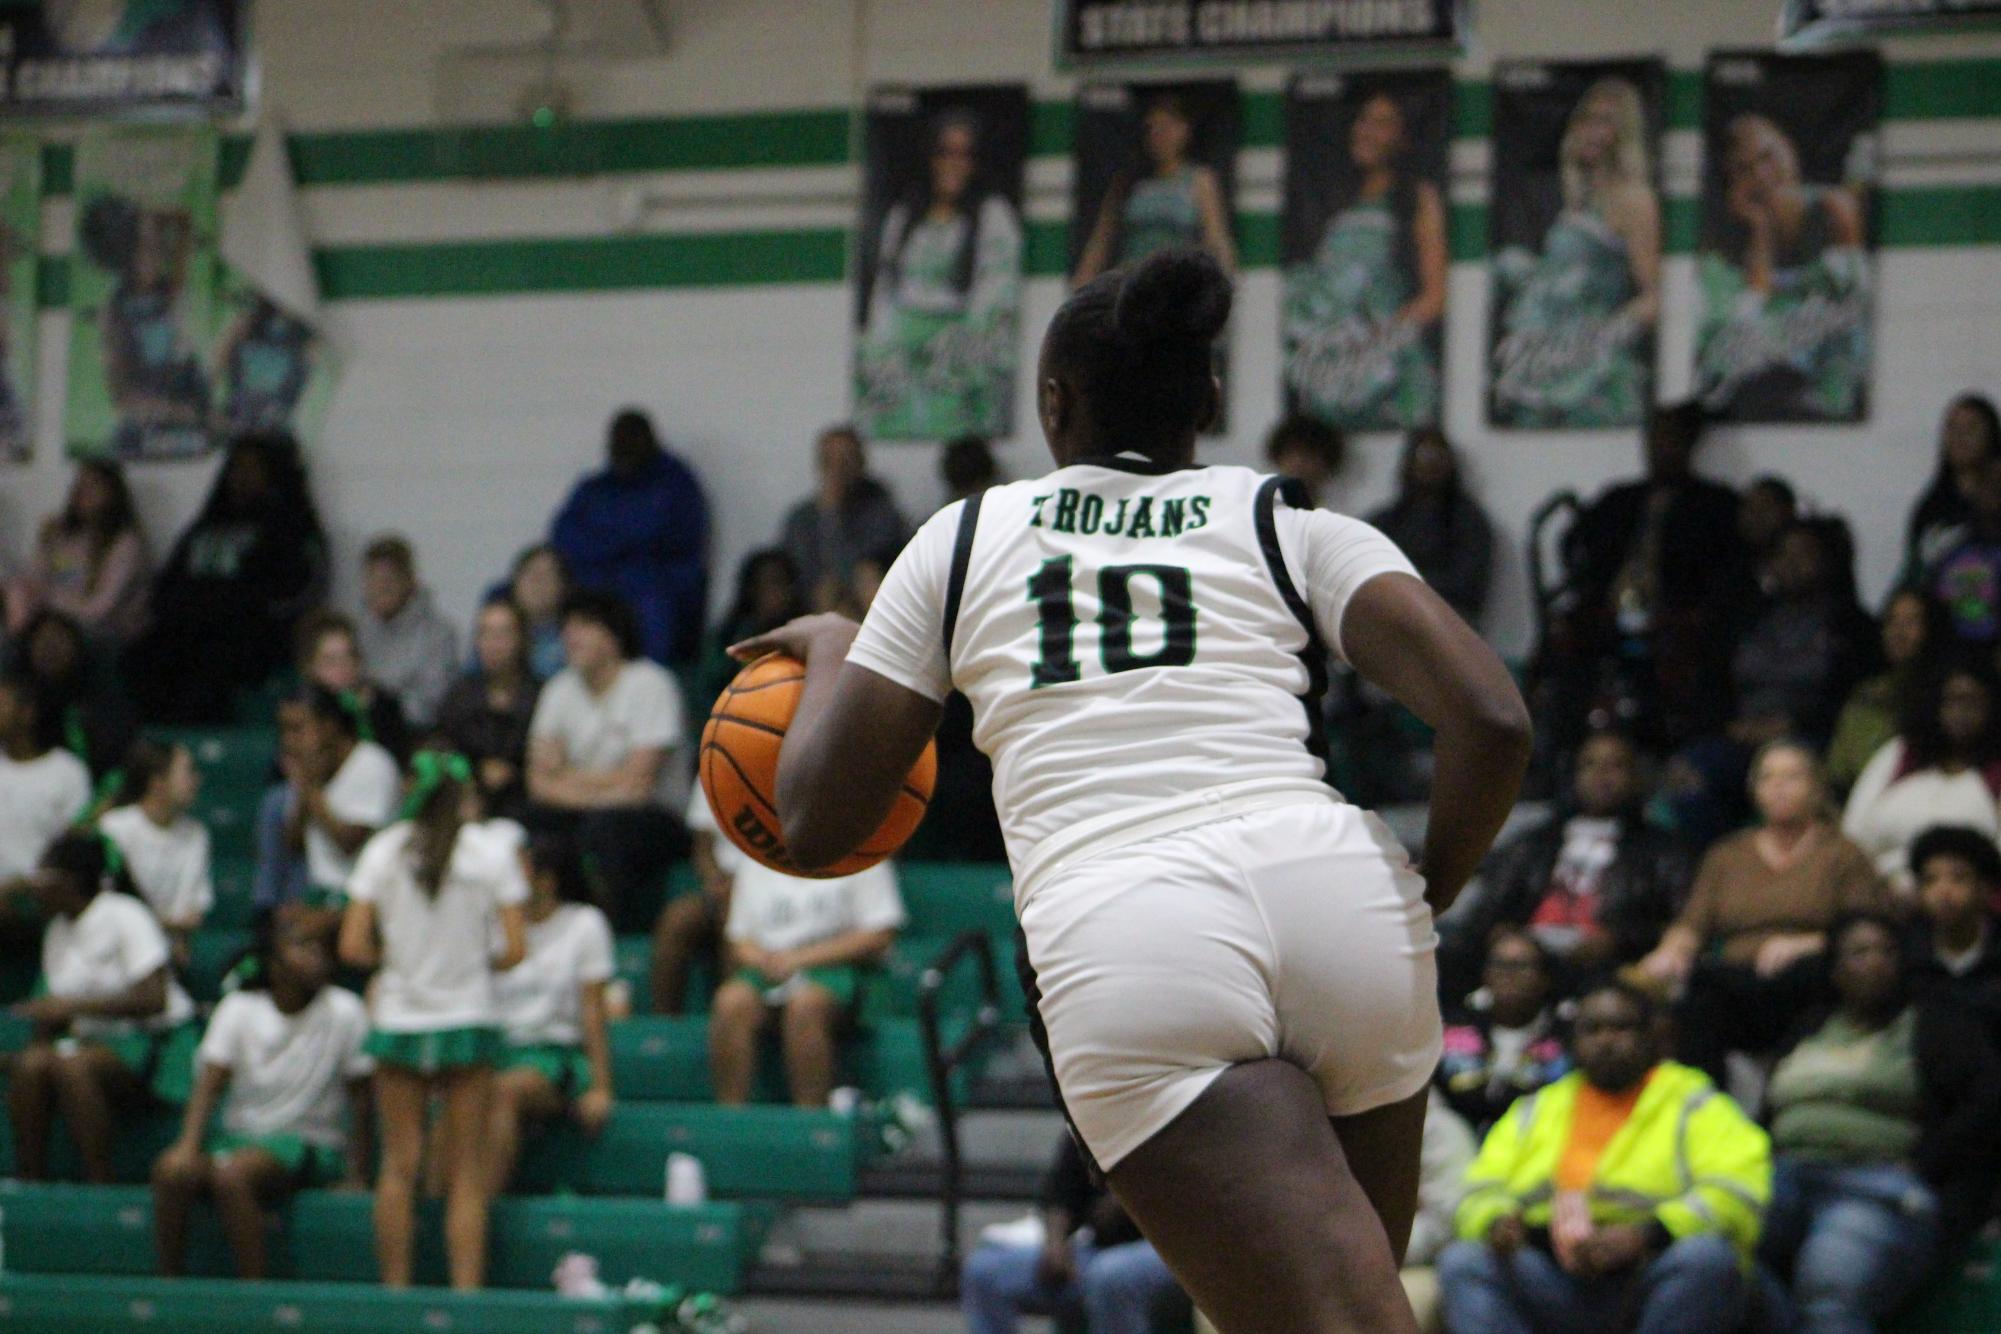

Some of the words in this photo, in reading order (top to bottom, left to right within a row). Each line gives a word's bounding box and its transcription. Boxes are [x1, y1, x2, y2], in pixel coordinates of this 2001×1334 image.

[1080, 4, 1189, 48] STATE
[1197, 0, 1435, 44] CHAMPIONS
[1030, 487, 1212, 539] TROJANS
[1026, 553, 1199, 690] 10
